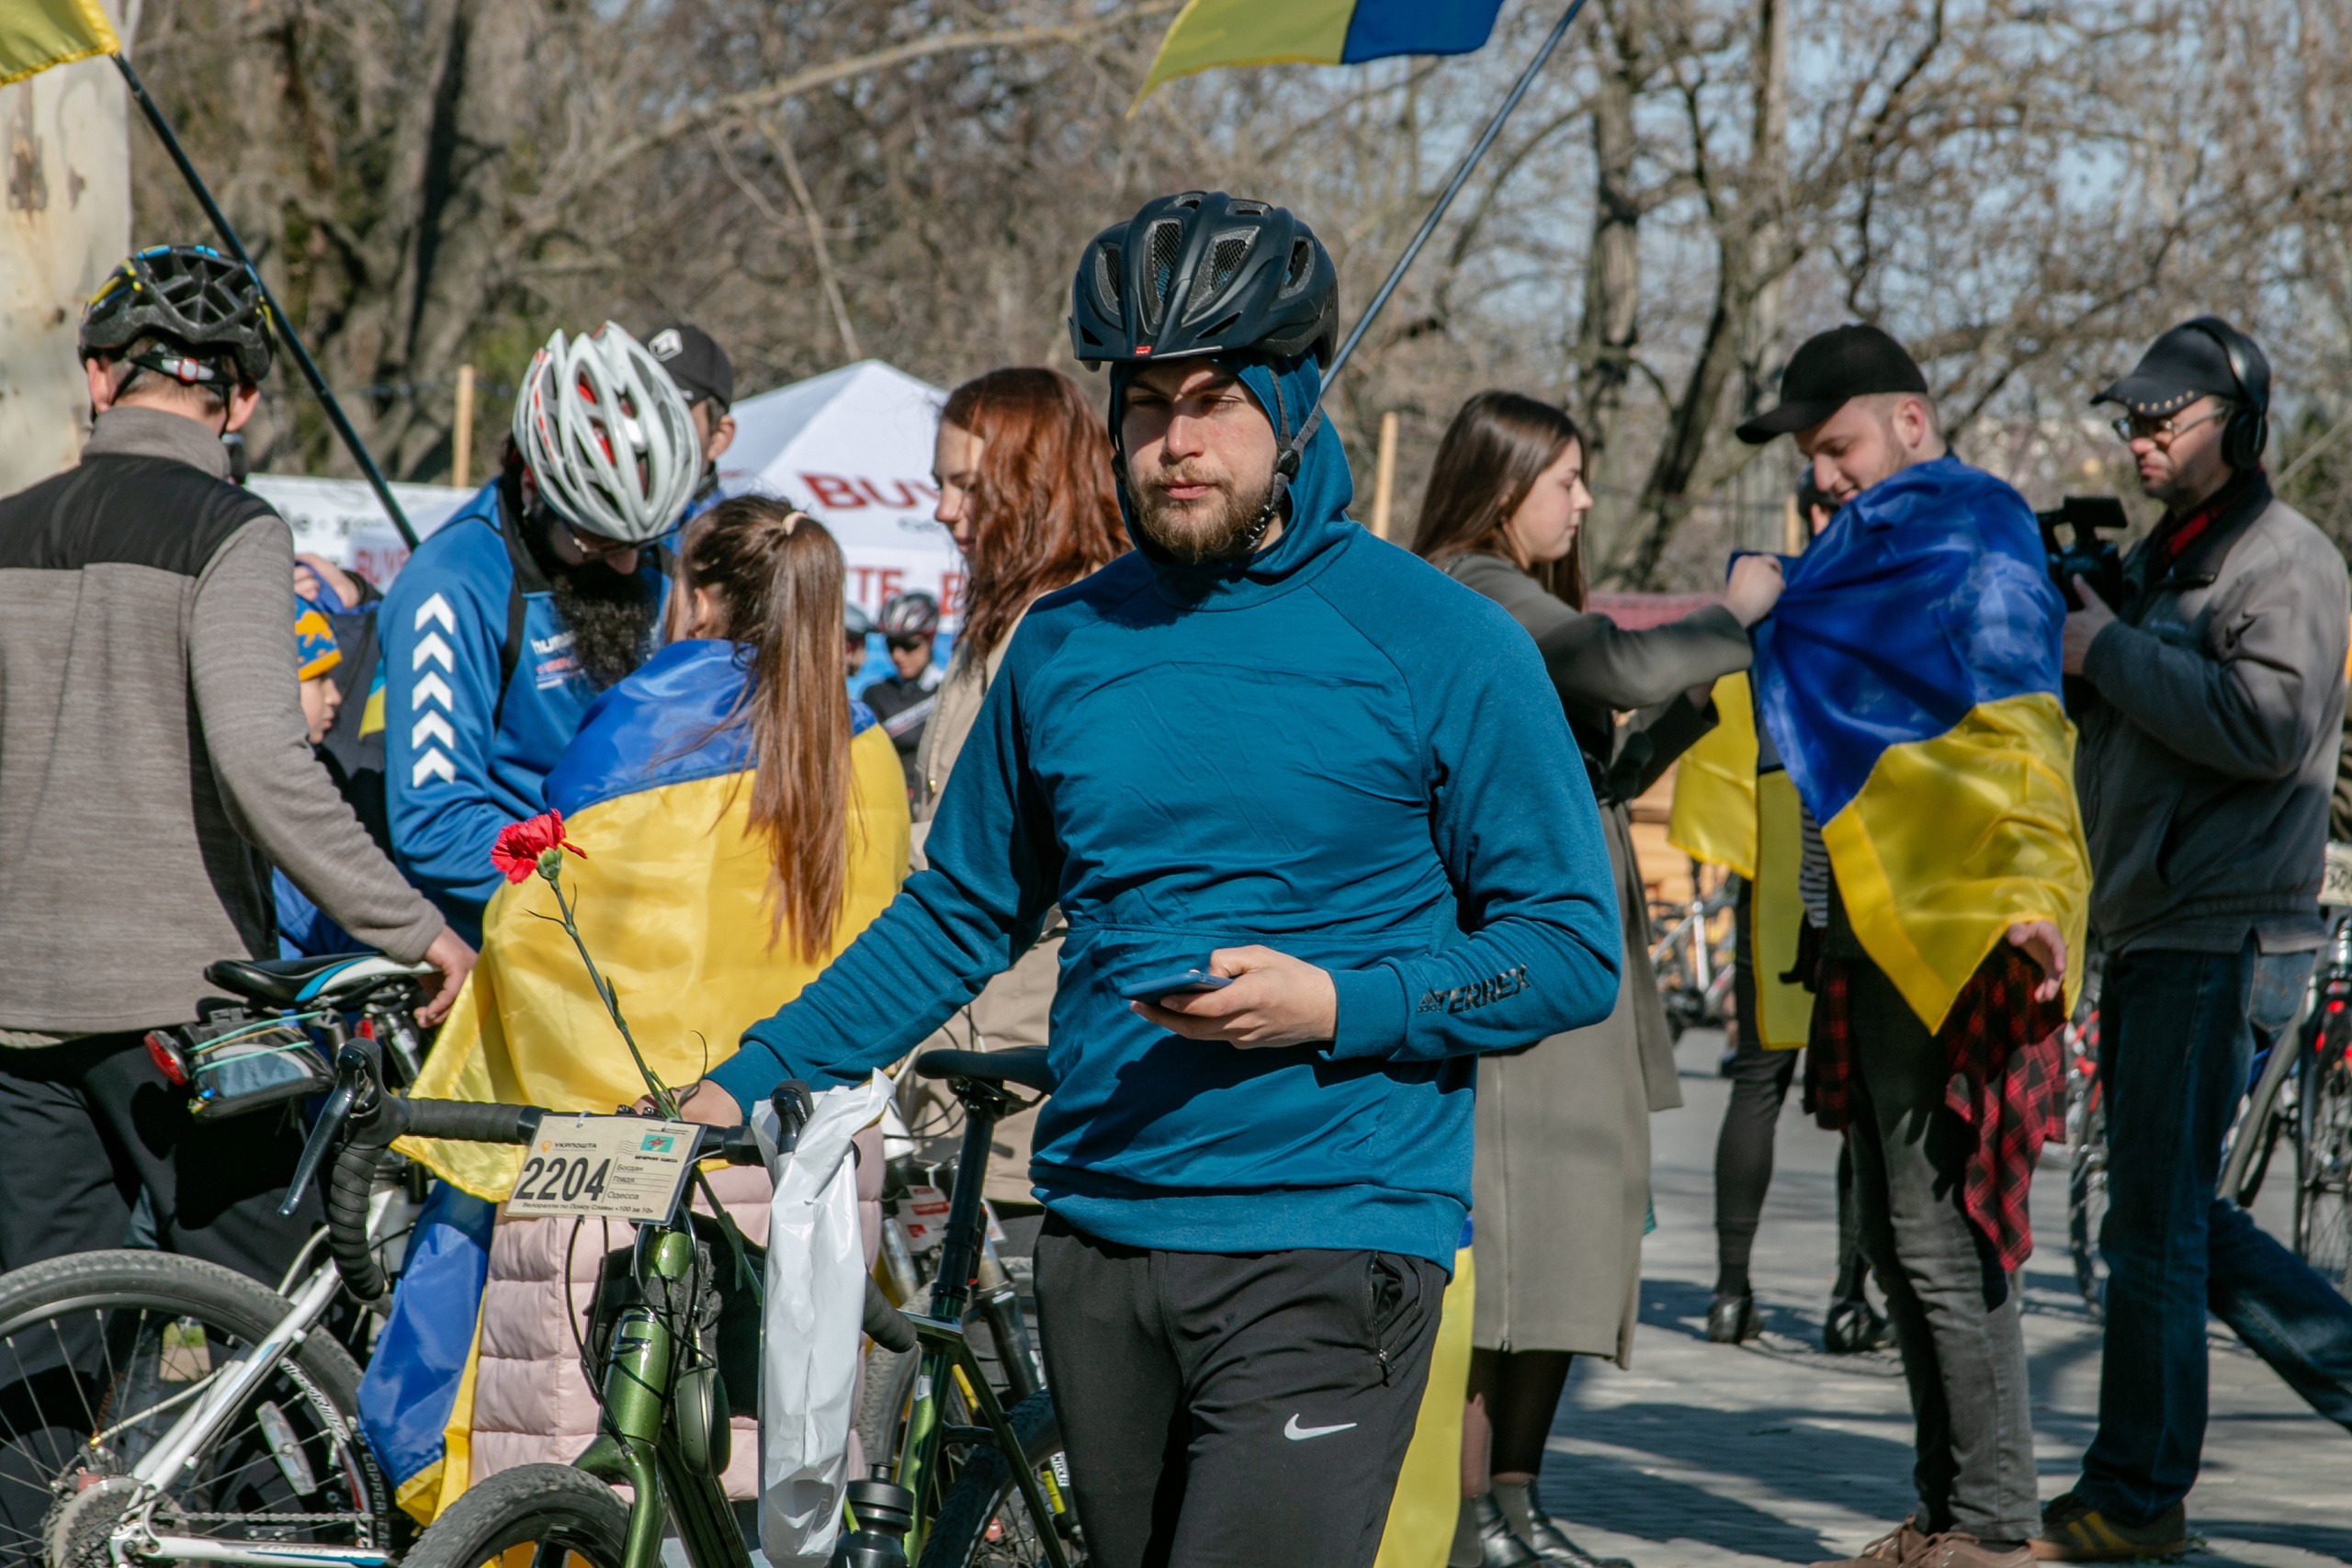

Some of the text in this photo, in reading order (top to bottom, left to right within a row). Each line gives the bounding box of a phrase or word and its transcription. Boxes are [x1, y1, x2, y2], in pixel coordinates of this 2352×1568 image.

[1435, 964, 1531, 1014] TERREX
[514, 1156, 611, 1201] 2204
[616, 1164, 643, 1172] Богдан
[607, 1190, 639, 1200] Одесса
